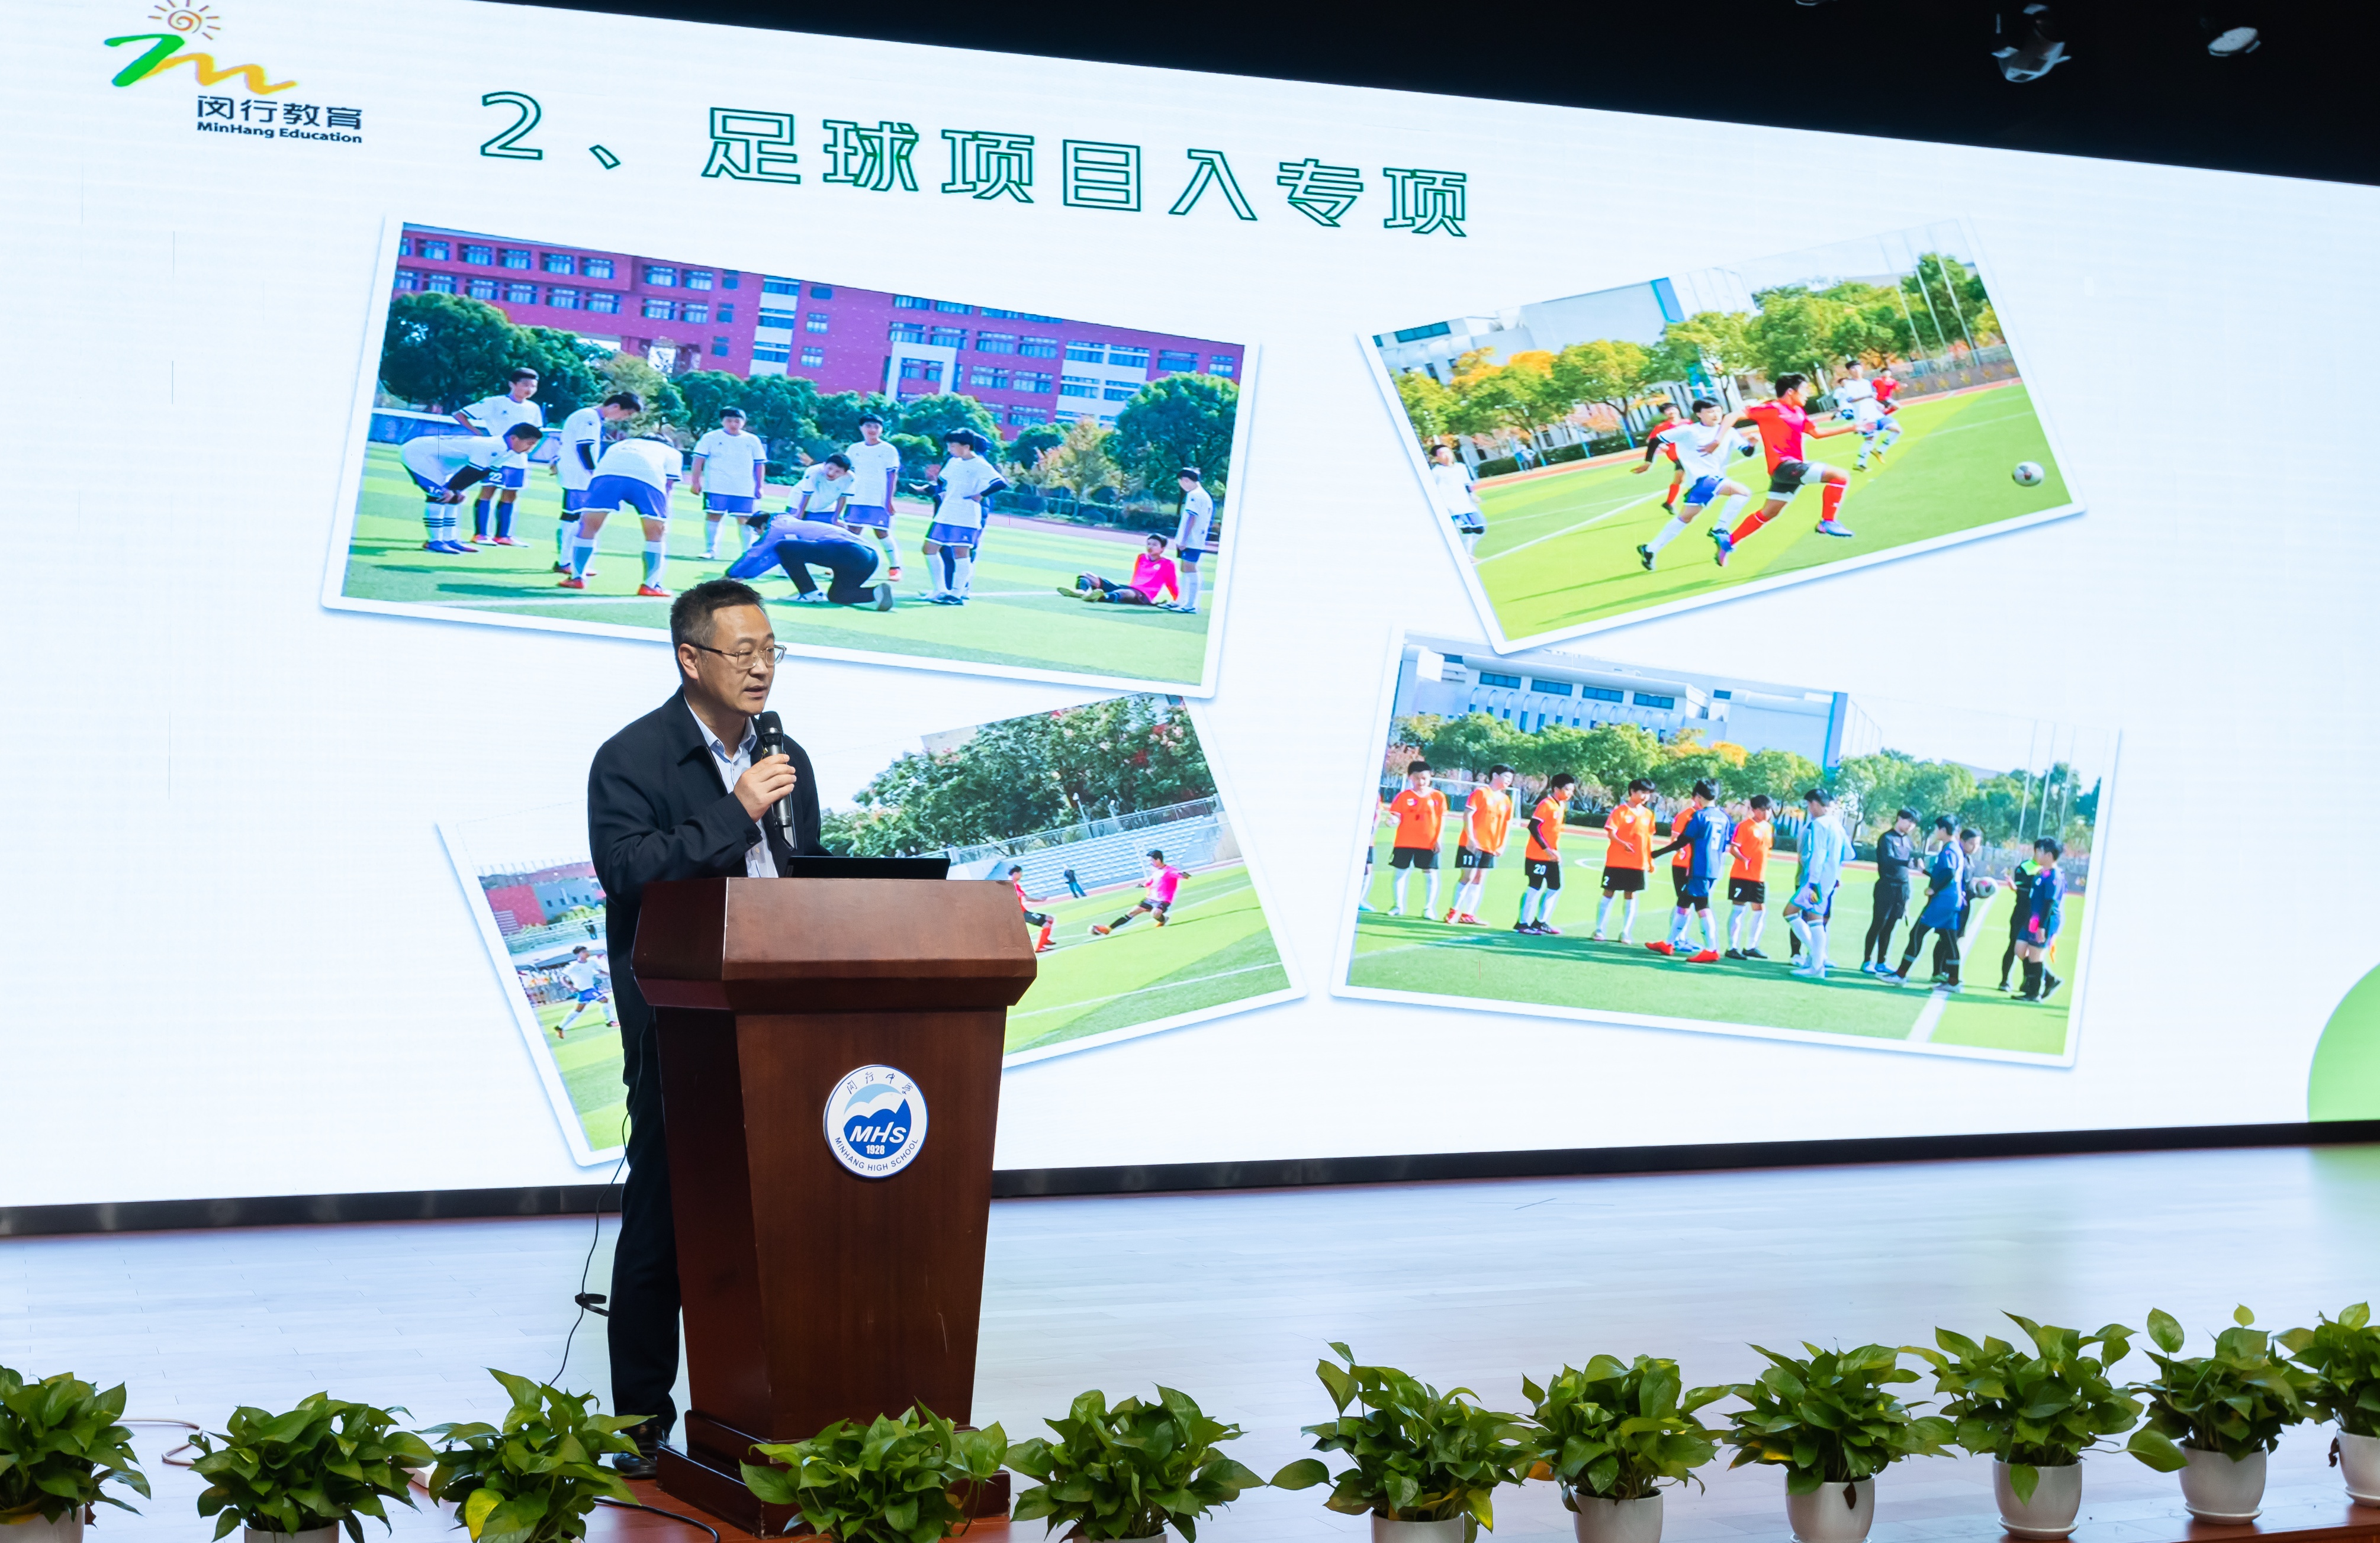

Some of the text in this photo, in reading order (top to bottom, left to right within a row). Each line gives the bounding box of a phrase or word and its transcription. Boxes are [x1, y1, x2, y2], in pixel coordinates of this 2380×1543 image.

[197, 95, 362, 130] 闵行教育
[197, 121, 363, 144] MinHang Education
[478, 90, 1468, 237] 2、足球项目入专项
[1462, 855, 1474, 865] 11
[1533, 864, 1547, 875] 20
[1733, 887, 1742, 898] 7
[849, 1122, 907, 1144] MHS
[834, 1137, 864, 1170] MINHANG
[890, 1139, 919, 1168] SCHOOL
[866, 1145, 885, 1155] 1928
